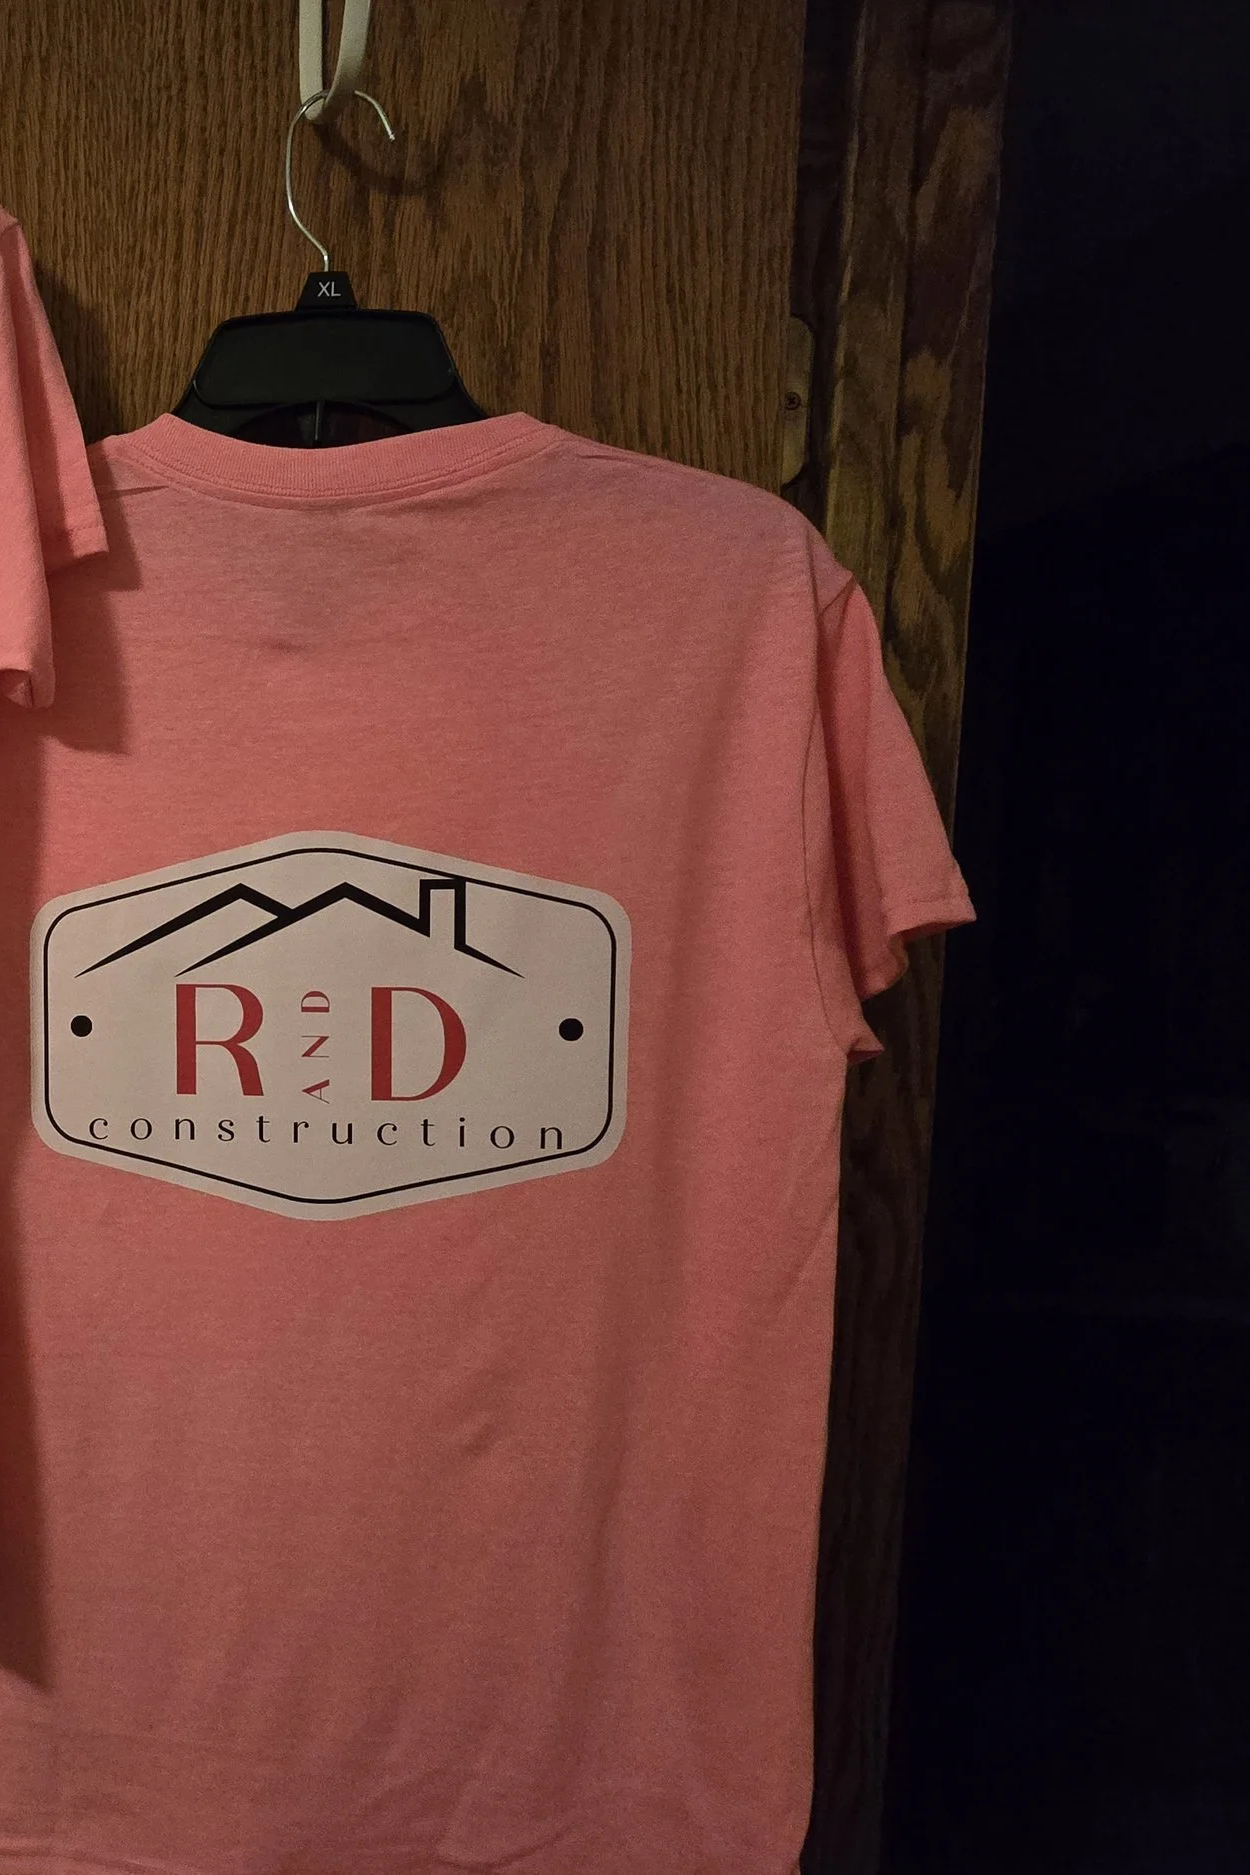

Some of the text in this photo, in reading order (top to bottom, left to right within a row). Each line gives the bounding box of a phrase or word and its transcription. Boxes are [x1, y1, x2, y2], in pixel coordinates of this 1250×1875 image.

[317, 281, 342, 297] XL
[175, 983, 467, 1104] R AND D
[89, 1116, 564, 1150] construction
